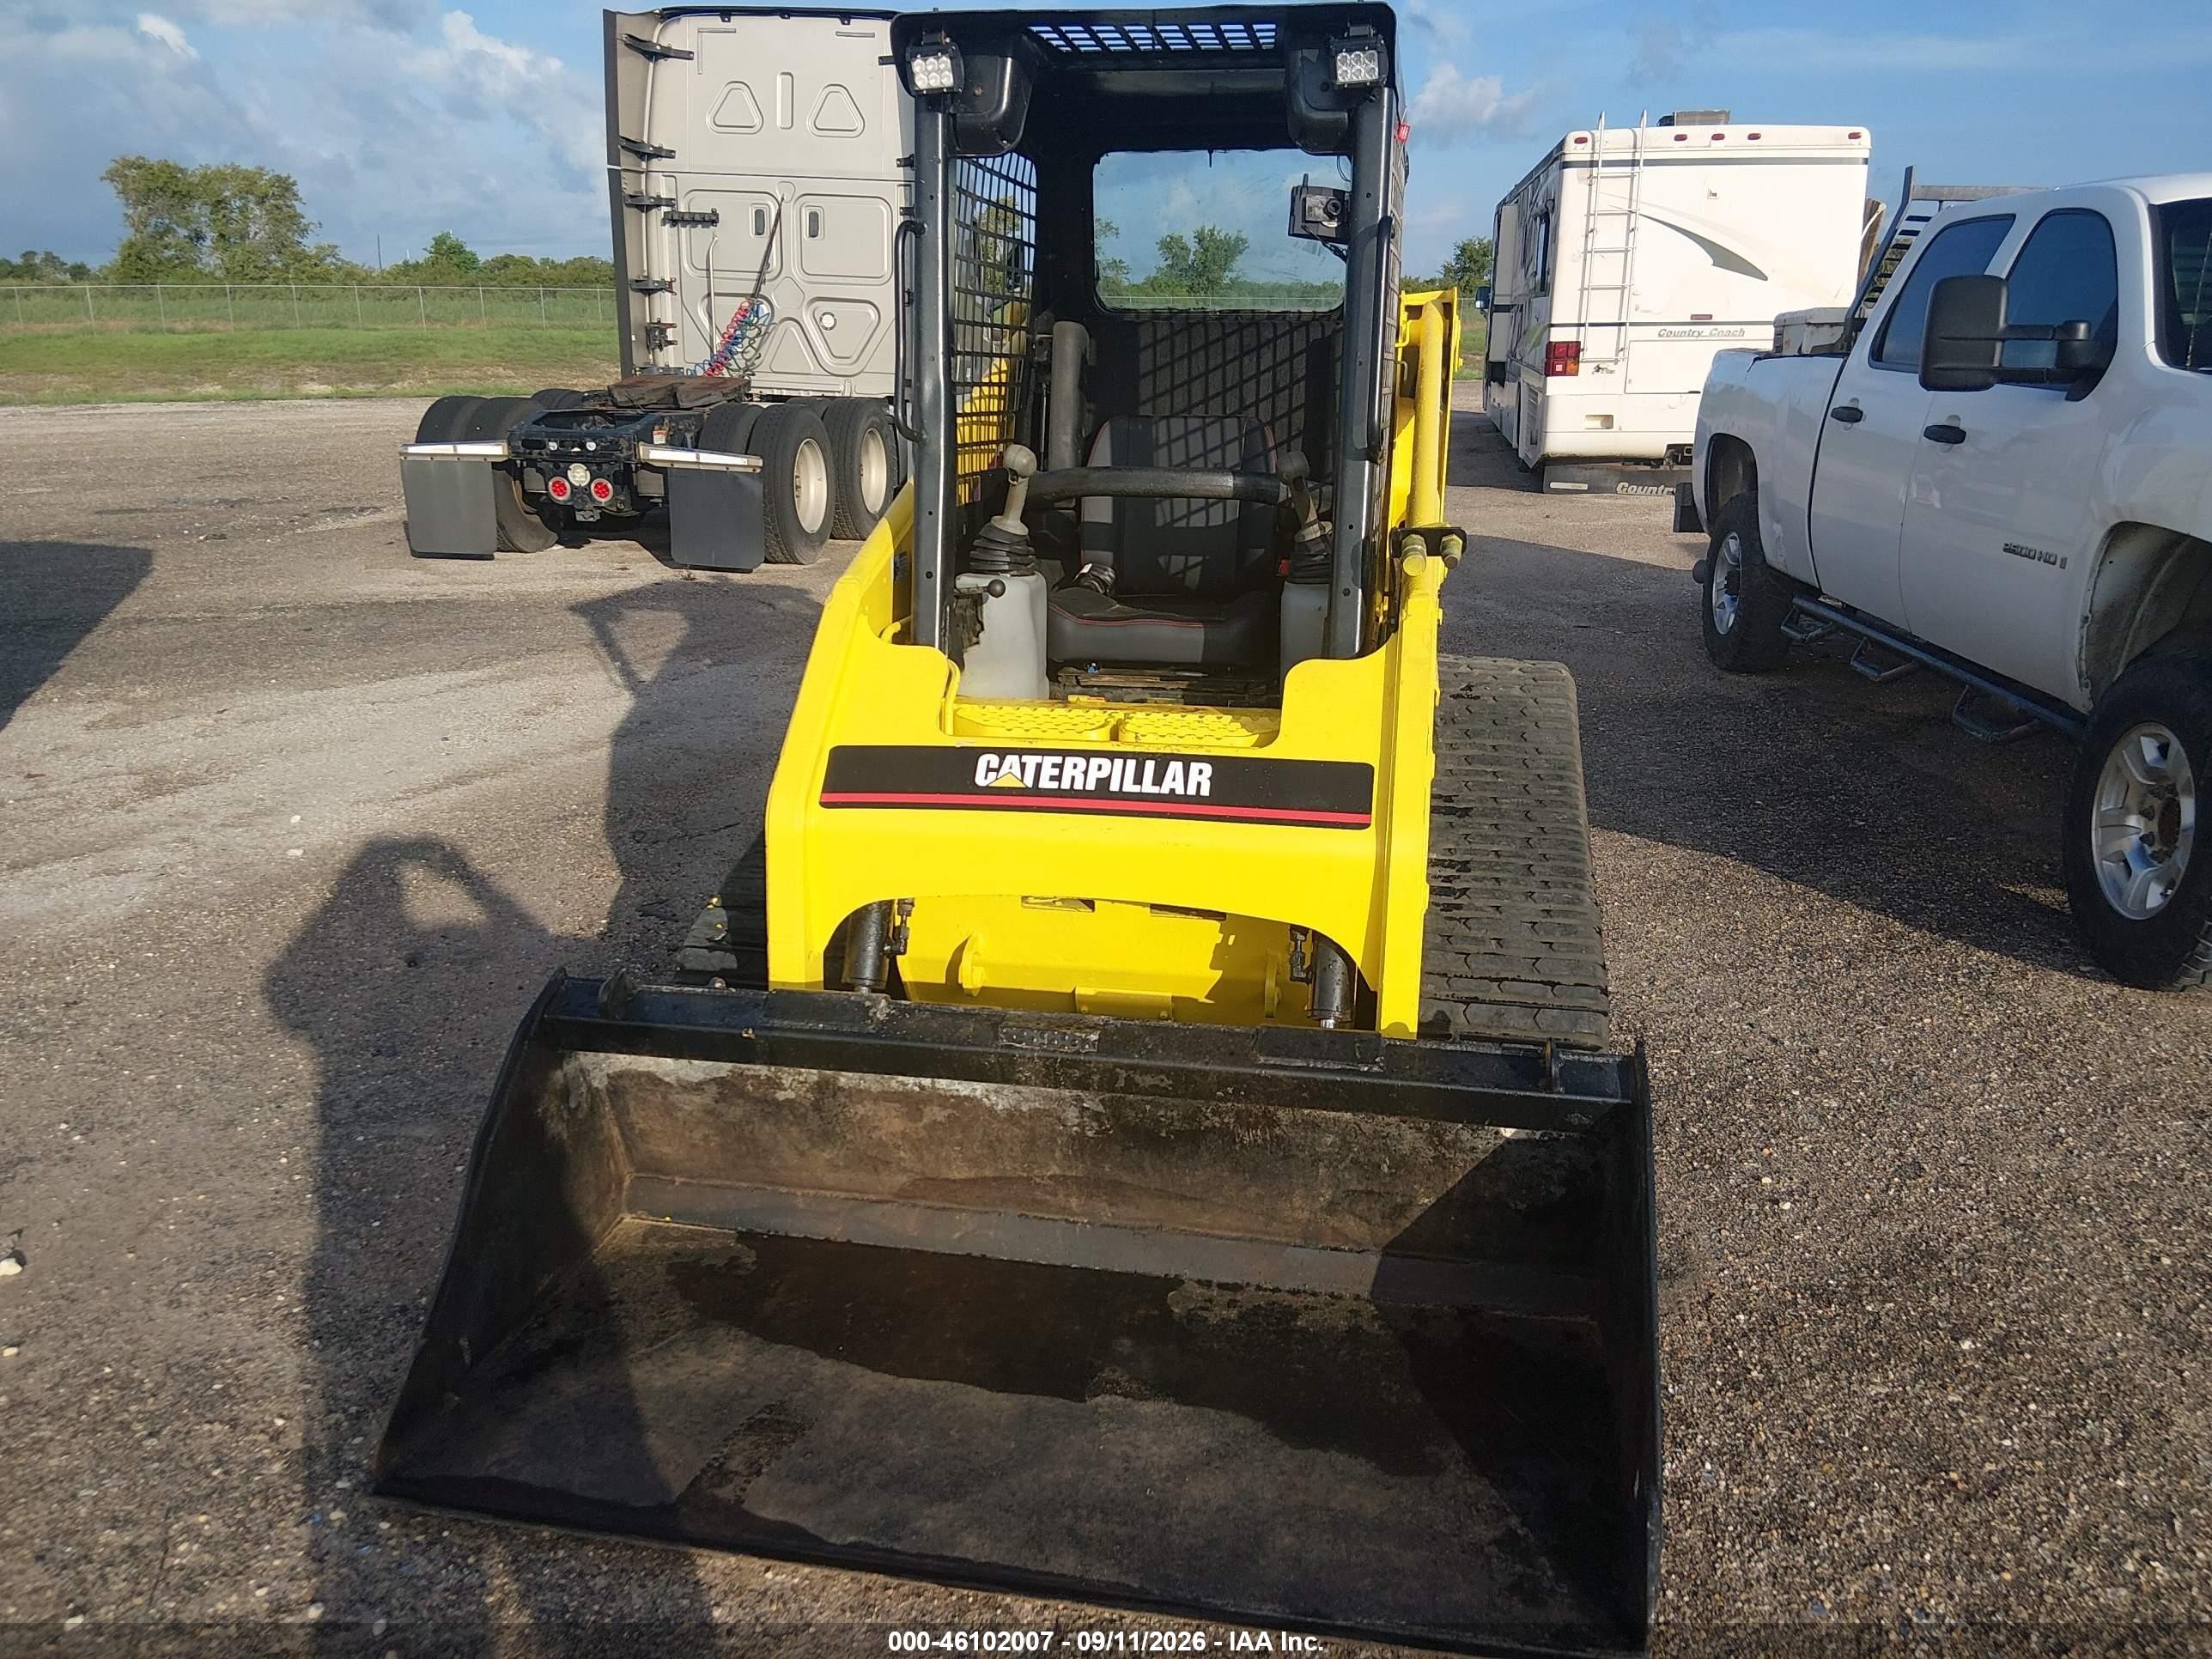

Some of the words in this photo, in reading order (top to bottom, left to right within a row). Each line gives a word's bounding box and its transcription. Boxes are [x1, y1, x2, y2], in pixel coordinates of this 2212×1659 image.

[1657, 328, 1704, 338] Country
[1708, 327, 1746, 337] Coach
[974, 753, 1213, 797] CATERPILLAR
